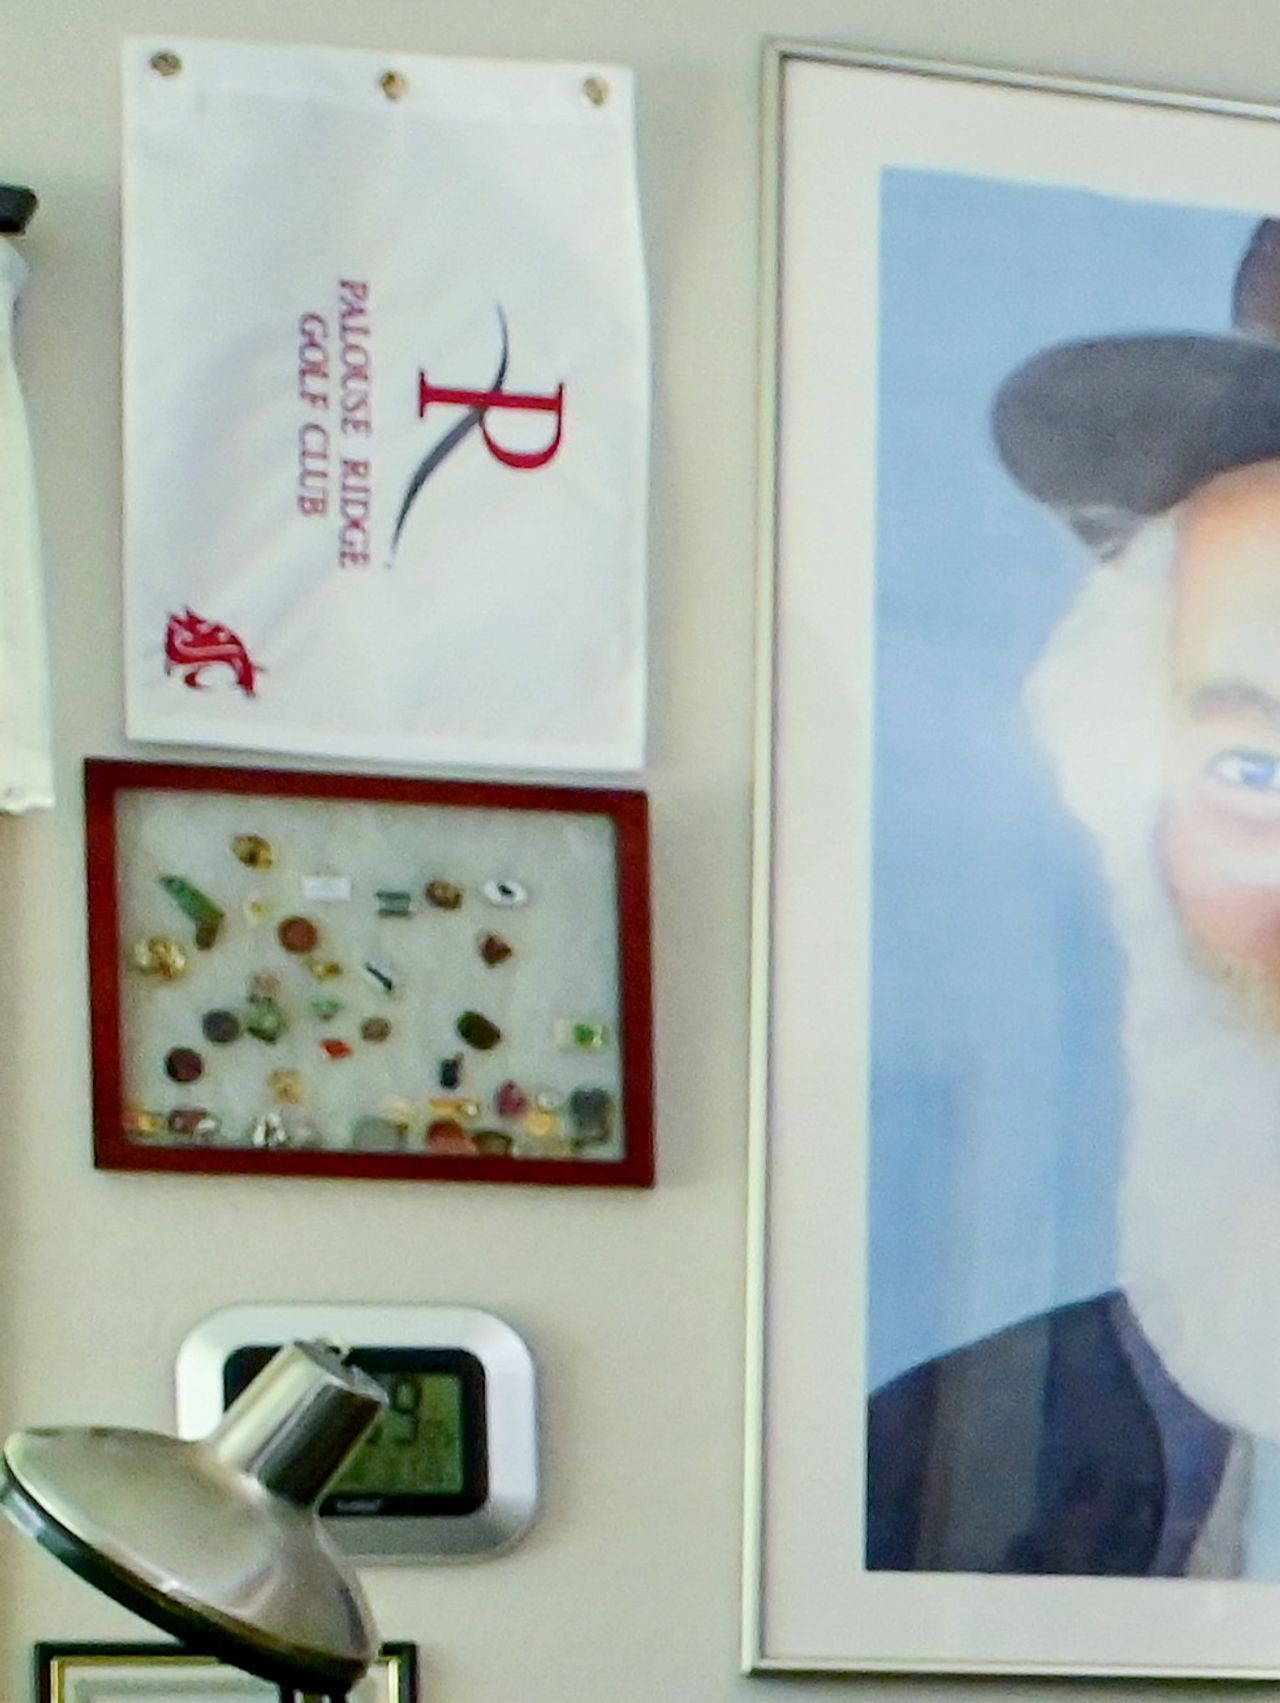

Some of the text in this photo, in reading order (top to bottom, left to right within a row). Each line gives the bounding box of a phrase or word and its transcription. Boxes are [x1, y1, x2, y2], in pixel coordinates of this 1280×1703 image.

[299, 312, 329, 516] GOLF CLUB
[339, 279, 371, 568] PALOUSE RIDGE
